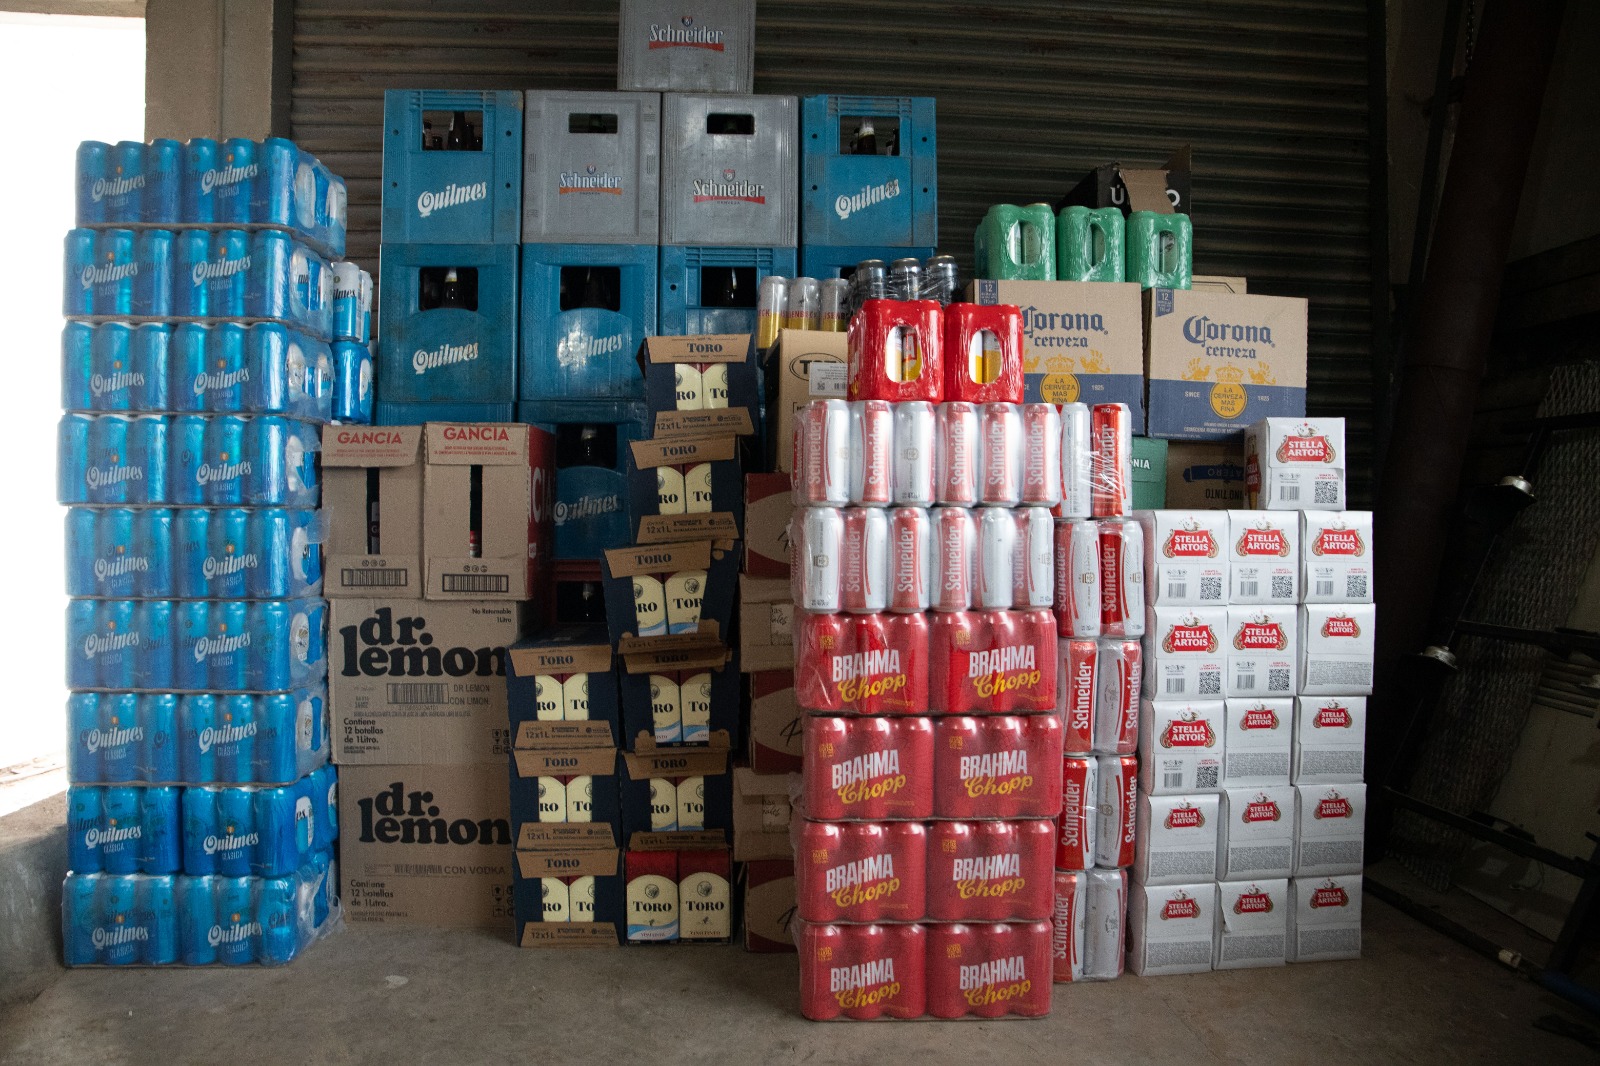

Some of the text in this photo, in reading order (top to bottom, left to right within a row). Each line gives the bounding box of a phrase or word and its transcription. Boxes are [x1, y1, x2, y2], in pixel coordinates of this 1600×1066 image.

[649, 23, 723, 44] Schneider
[92, 176, 145, 202] Quilmes
[201, 163, 258, 196] Quilmes
[559, 172, 621, 189] Schneider
[693, 178, 764, 198] Schneider
[418, 181, 487, 218] Quilmes
[835, 177, 900, 220] Quilmes
[81, 260, 138, 290] Quilmes
[193, 255, 251, 286] Quilmes
[1162, 292, 1169, 301] 12
[1034, 335, 1088, 348] cerveza
[1183, 315, 1273, 347] Corona
[413, 341, 478, 374] Quilmes
[687, 343, 722, 352] TORO
[1206, 345, 1256, 359] cerveza
[91, 372, 144, 397] Quilmes
[193, 367, 249, 394] Quilmes
[338, 432, 402, 444] GANCIA
[443, 427, 509, 441] GANCIA
[661, 445, 696, 456] TORO
[808, 418, 823, 484] Schneider
[951, 420, 966, 486] Schneider
[989, 421, 1005, 486] Schneider
[1028, 421, 1043, 485] Schneider
[1288, 448, 1324, 457] ARTOIS
[86, 464, 142, 488] Quilmes
[196, 460, 252, 484] Quilmes
[553, 493, 617, 526] Quilmes
[1174, 535, 1208, 543] STELLA
[1174, 543, 1208, 551] ARTOIS
[1246, 542, 1280, 550] ARTOIS
[1247, 534, 1279, 542] STELLA
[1322, 542, 1355, 550] ARTOIS
[1323, 534, 1355, 542] STELLA
[94, 555, 148, 581] Quilmes
[203, 553, 257, 578] Quilmes
[635, 554, 671, 564] TORO
[846, 527, 860, 592] Schneider
[898, 527, 914, 592] Schneider
[945, 526, 961, 591] Schneider
[1102, 544, 1116, 613] Schneider
[360, 607, 433, 645] dr.
[1174, 630, 1208, 638] STELLA
[1245, 627, 1277, 636] STELLA
[84, 630, 139, 660] Quilmes
[194, 629, 251, 662] Quilmes
[340, 625, 506, 676] lemon
[1173, 638, 1208, 647] ARTOIS
[1244, 636, 1278, 644] ARTOIS
[538, 655, 573, 665] TORO
[832, 649, 900, 682] BRAHMA
[969, 645, 1035, 678] BRAHMA
[454, 684, 465, 692] DR
[837, 674, 907, 703] Chopp
[973, 669, 1041, 699] Chopp
[1073, 662, 1093, 730] Schneider
[1126, 661, 1141, 731] Schneider
[450, 697, 466, 705] CON
[344, 718, 375, 726] Contiene
[355, 726, 383, 735] botellas
[1172, 725, 1205, 733] STELLA
[87, 725, 143, 754] Quilmes
[199, 721, 257, 751] Quilmes
[1171, 733, 1206, 742] ARTOIS
[543, 758, 577, 766] TORO
[653, 759, 687, 768] TORO
[832, 749, 899, 790] BRAHMA
[960, 750, 1027, 780] BRAHMA
[375, 782, 439, 816] dr.
[837, 774, 906, 805] Chopp
[964, 775, 1033, 798] Chopp
[358, 798, 511, 844] lemon
[1062, 779, 1080, 847] Schneider
[85, 827, 141, 852] Quilmes
[203, 831, 258, 854] Quilmes
[445, 866, 505, 875] CON VODKA
[545, 858, 579, 868] TORO
[826, 853, 893, 893] BRAHMA
[953, 854, 1020, 881] BRAHMA
[351, 880, 385, 888] Contiene
[351, 889, 359, 897] 12
[831, 878, 900, 907] Chopp
[957, 878, 1025, 899] Chopp
[633, 901, 672, 912] TORO
[686, 901, 724, 911] TORO
[92, 925, 149, 950] Quilmes
[207, 923, 262, 948] Quilmes
[1053, 893, 1069, 960] Schneider
[831, 958, 894, 992] BRAHMA
[960, 956, 1025, 990] BRAHMA
[835, 982, 900, 1009] Chopp
[964, 979, 1031, 1007] Chopp
